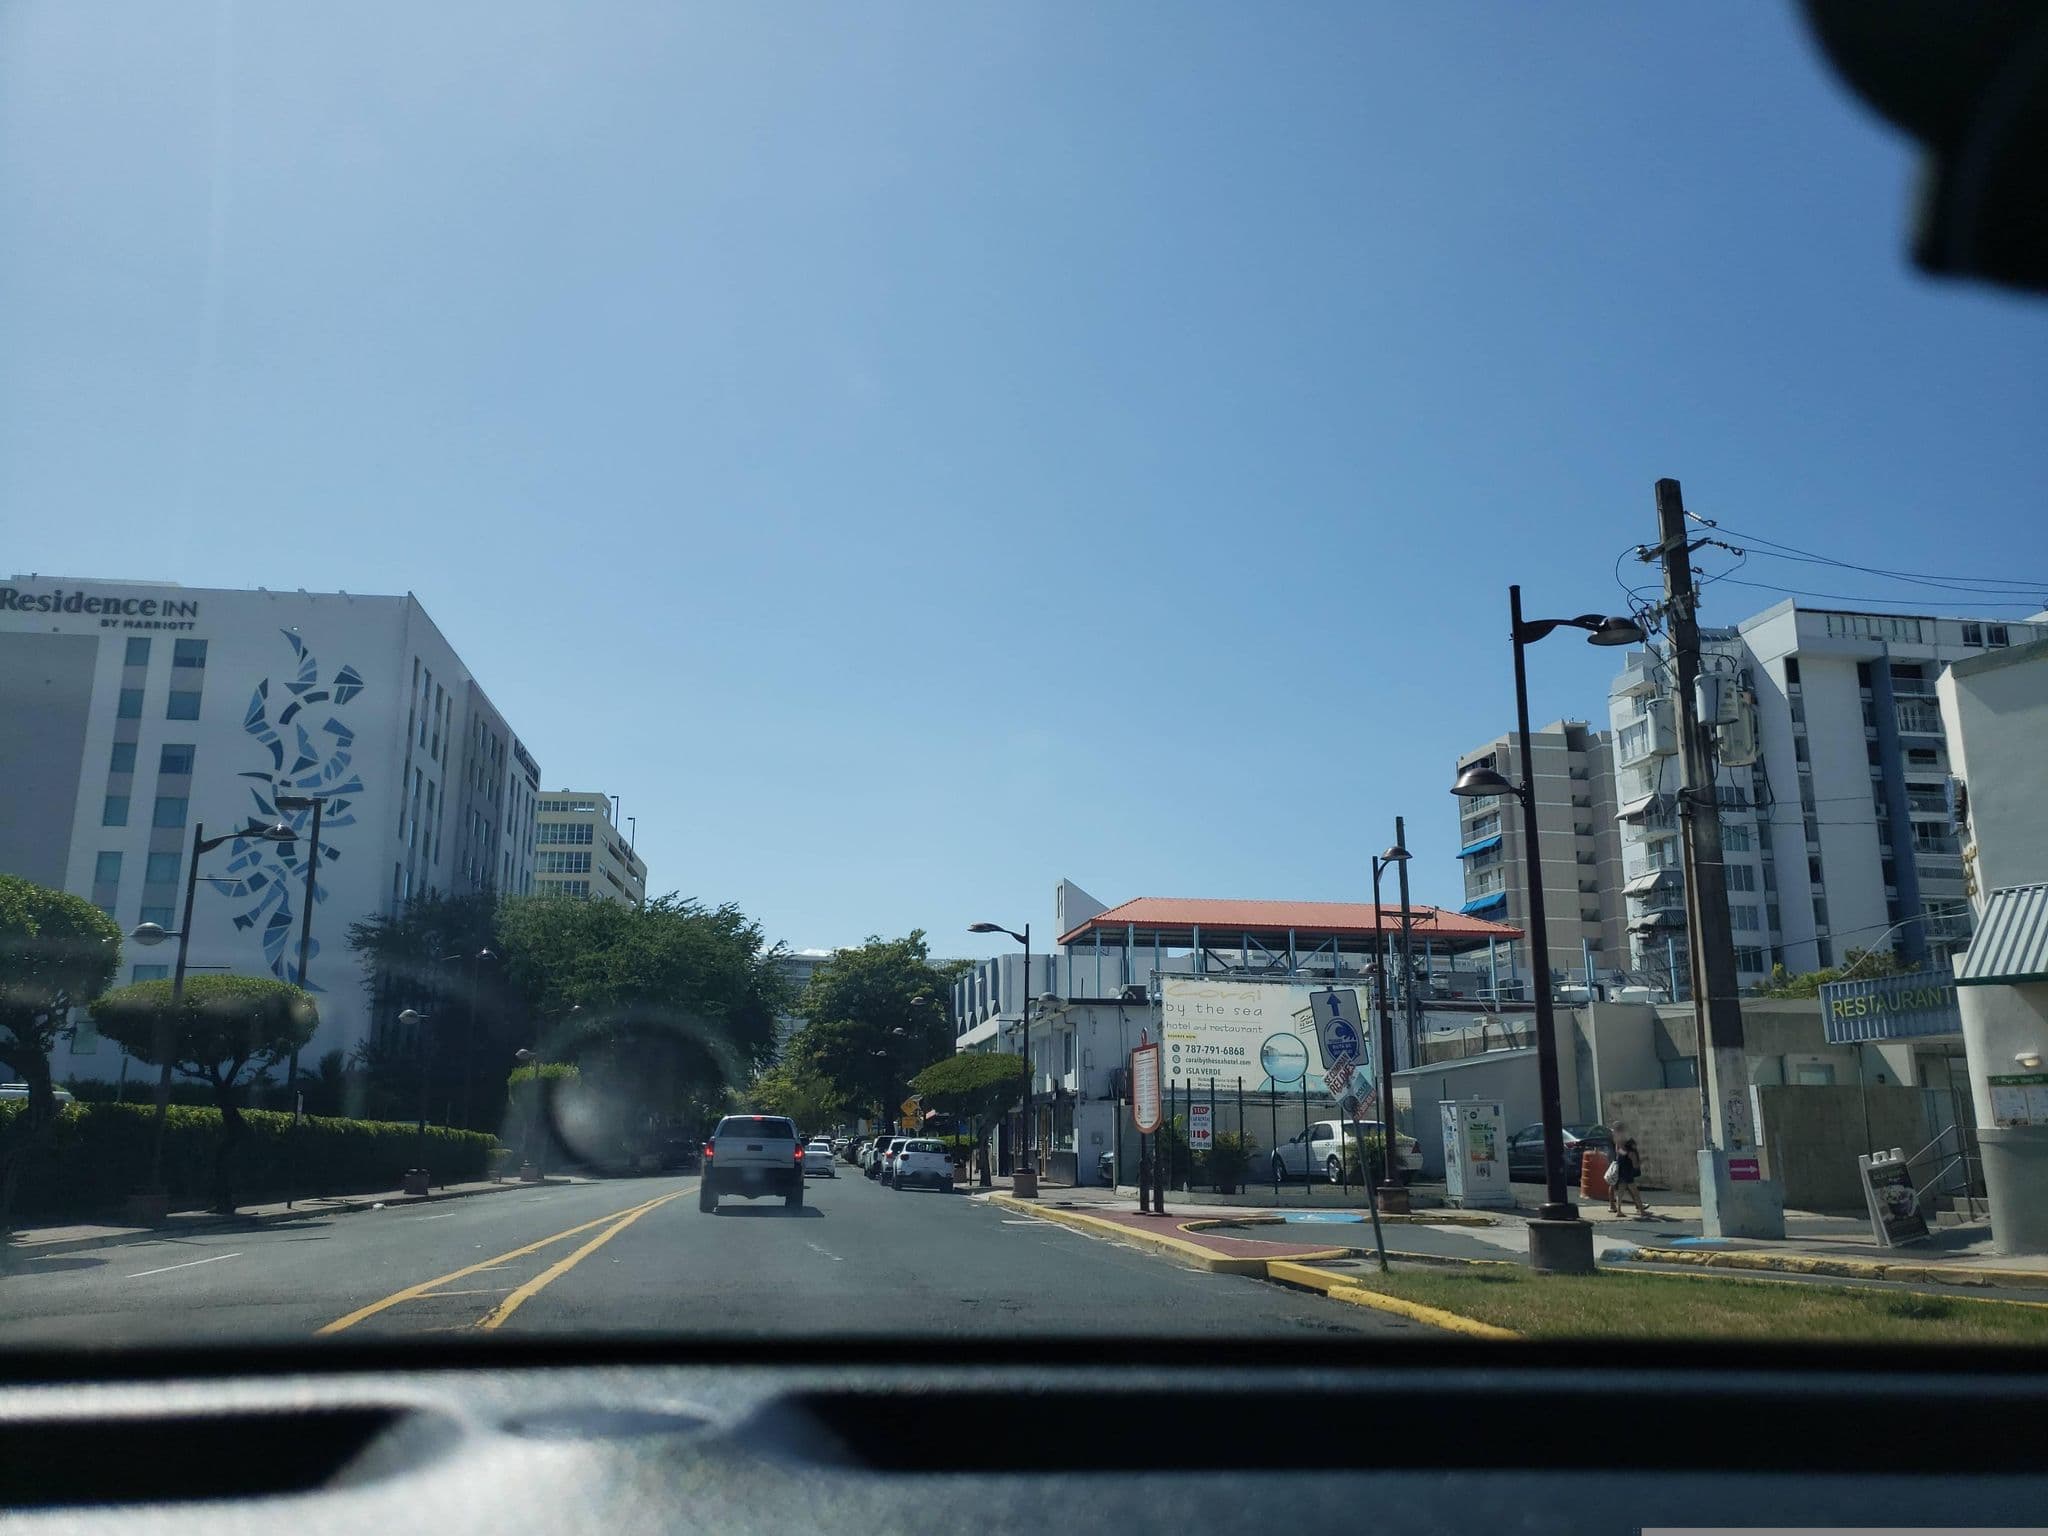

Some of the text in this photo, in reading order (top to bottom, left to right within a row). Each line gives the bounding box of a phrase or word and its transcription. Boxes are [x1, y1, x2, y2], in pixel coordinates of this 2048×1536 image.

[0, 588, 197, 617] Residence INN
[101, 619, 195, 631] BY MARRIOTT
[1831, 986, 1952, 1019] RESTAURANT
[1166, 1002, 1263, 1016] by the sea
[1166, 1021, 1191, 1030] hotel
[1210, 1025, 1263, 1033] restaurant
[1185, 1044, 1245, 1055] 787-791-6868
[1200, 1067, 1221, 1075] VERDE
